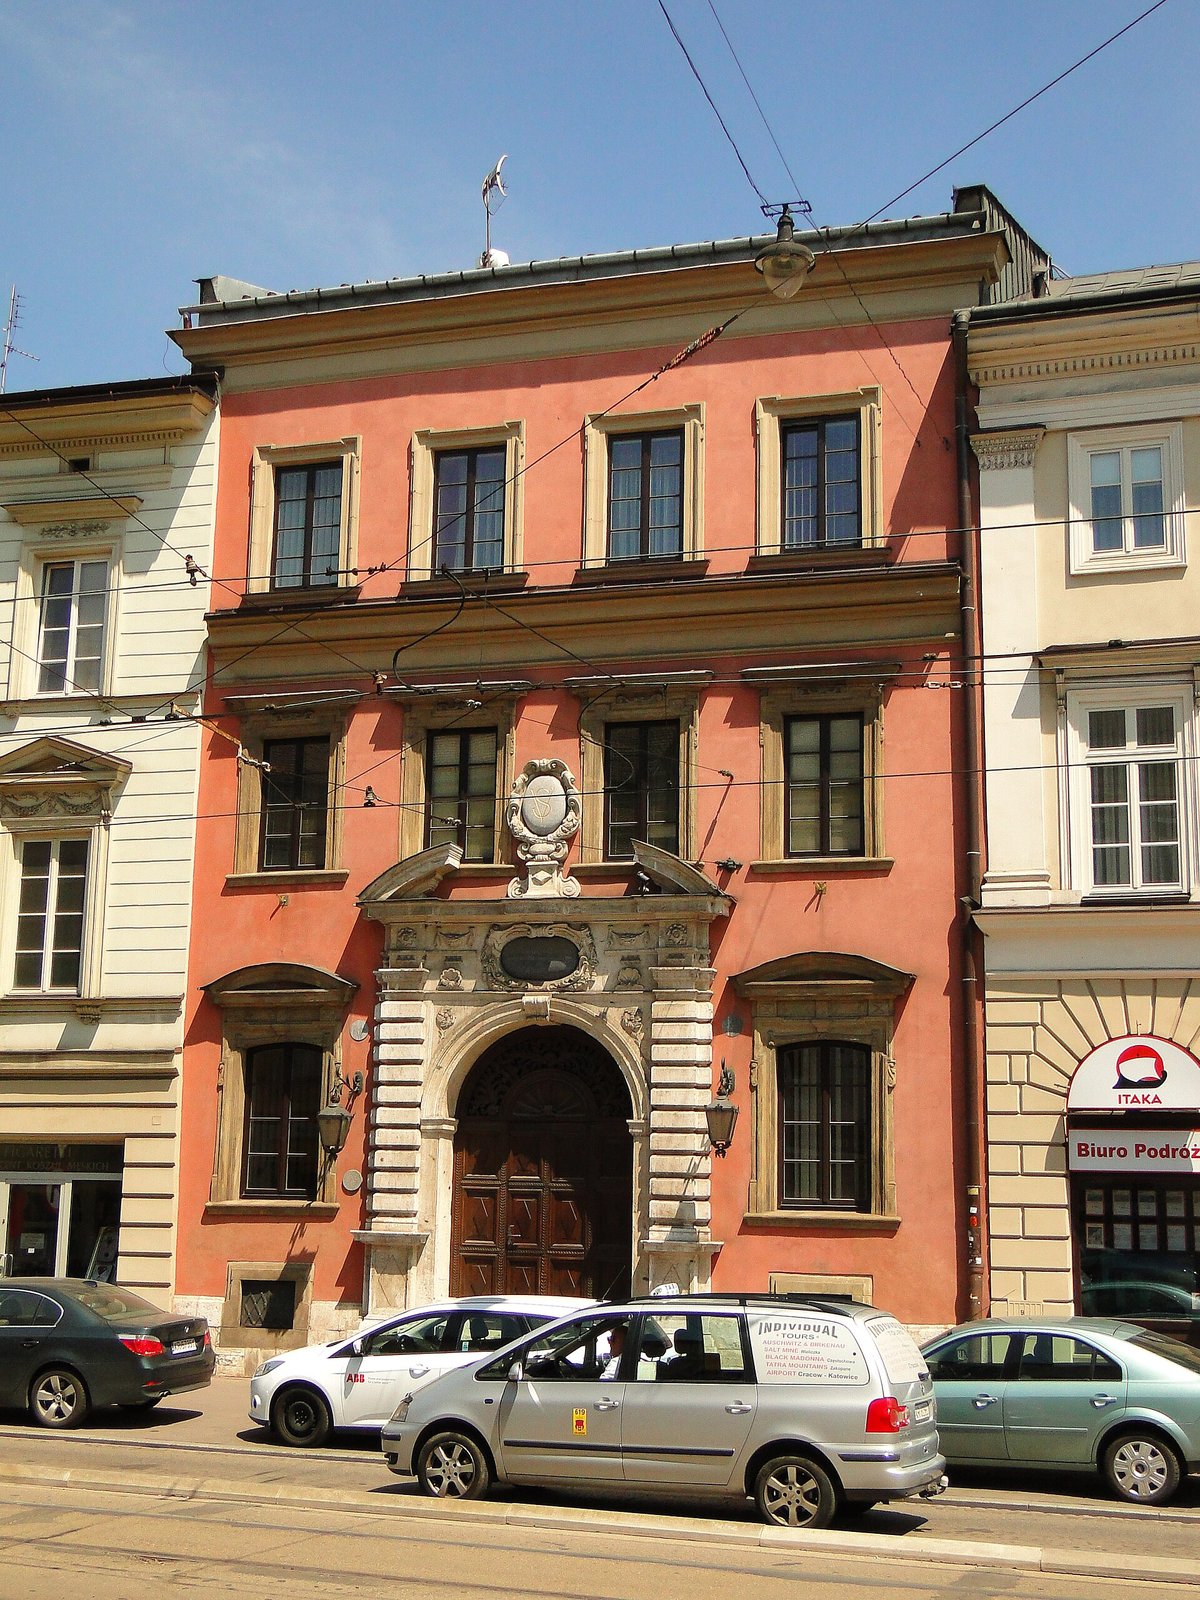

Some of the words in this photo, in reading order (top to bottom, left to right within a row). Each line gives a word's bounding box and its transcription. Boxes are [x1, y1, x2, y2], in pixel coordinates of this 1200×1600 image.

[1118, 1094, 1162, 1105] ITAKA
[1077, 1142, 1128, 1159] Biuro
[1134, 1143, 1200, 1159] Podróż
[758, 1322, 838, 1338] INDIVIDUAL
[781, 1332, 815, 1340] TOURS
[346, 1373, 365, 1383] ABB
[574, 1408, 586, 1416] 619
